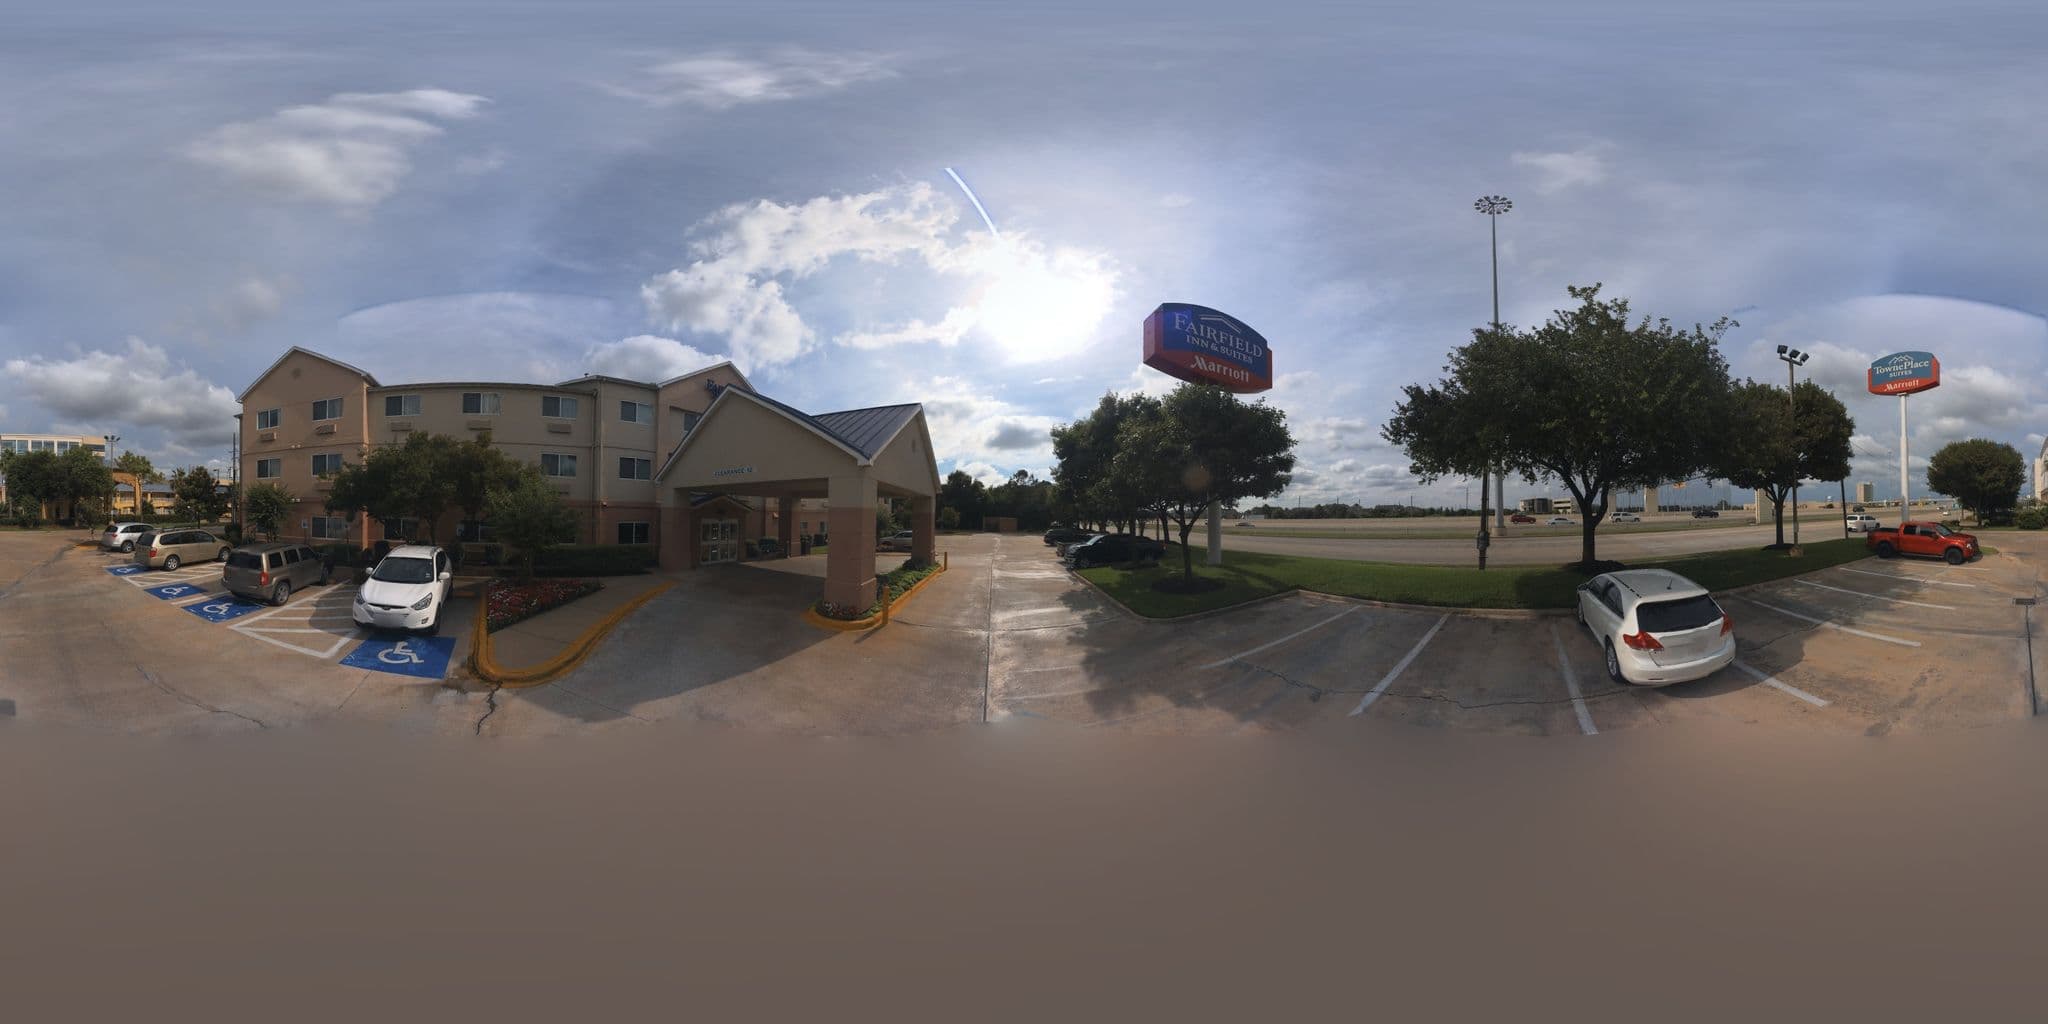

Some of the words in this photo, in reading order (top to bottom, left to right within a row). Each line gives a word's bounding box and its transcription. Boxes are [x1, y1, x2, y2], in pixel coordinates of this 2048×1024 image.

[1175, 312, 1262, 357] FAIRFIELD
[1186, 334, 1209, 348] INN
[1210, 343, 1219, 352] &
[1220, 345, 1253, 364] SUITES
[1190, 355, 1249, 382] Marriott
[1873, 360, 1929, 375] TownePlace
[1889, 370, 1912, 378] SUITES
[1884, 379, 1919, 392] Marriott
